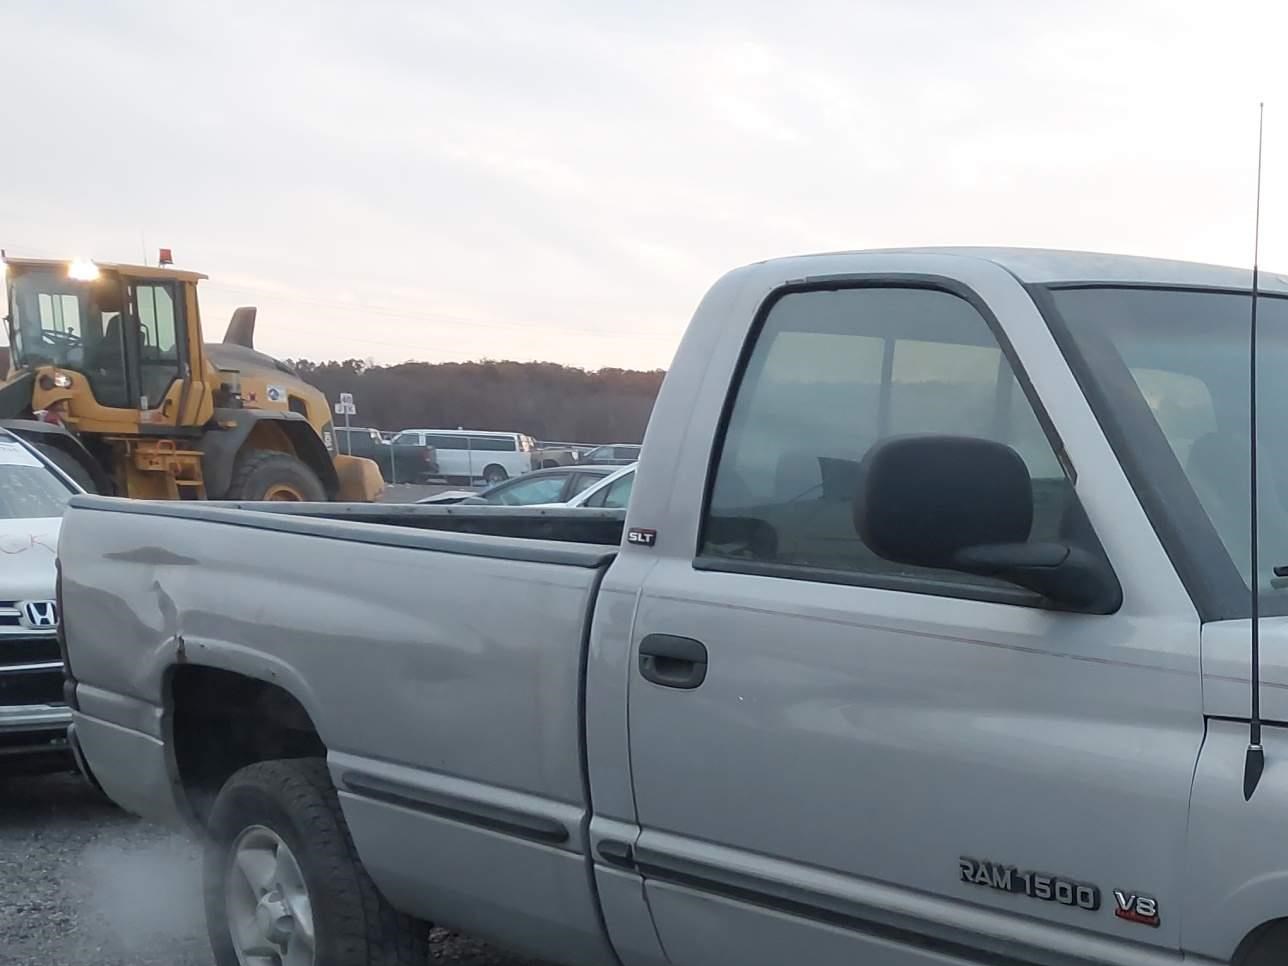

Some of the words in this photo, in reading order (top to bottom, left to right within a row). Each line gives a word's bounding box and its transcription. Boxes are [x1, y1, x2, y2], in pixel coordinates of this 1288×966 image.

[628, 531, 654, 543] SLT
[959, 858, 1013, 891] RAM
[1023, 873, 1097, 909] 1500
[1114, 890, 1157, 917] V8
